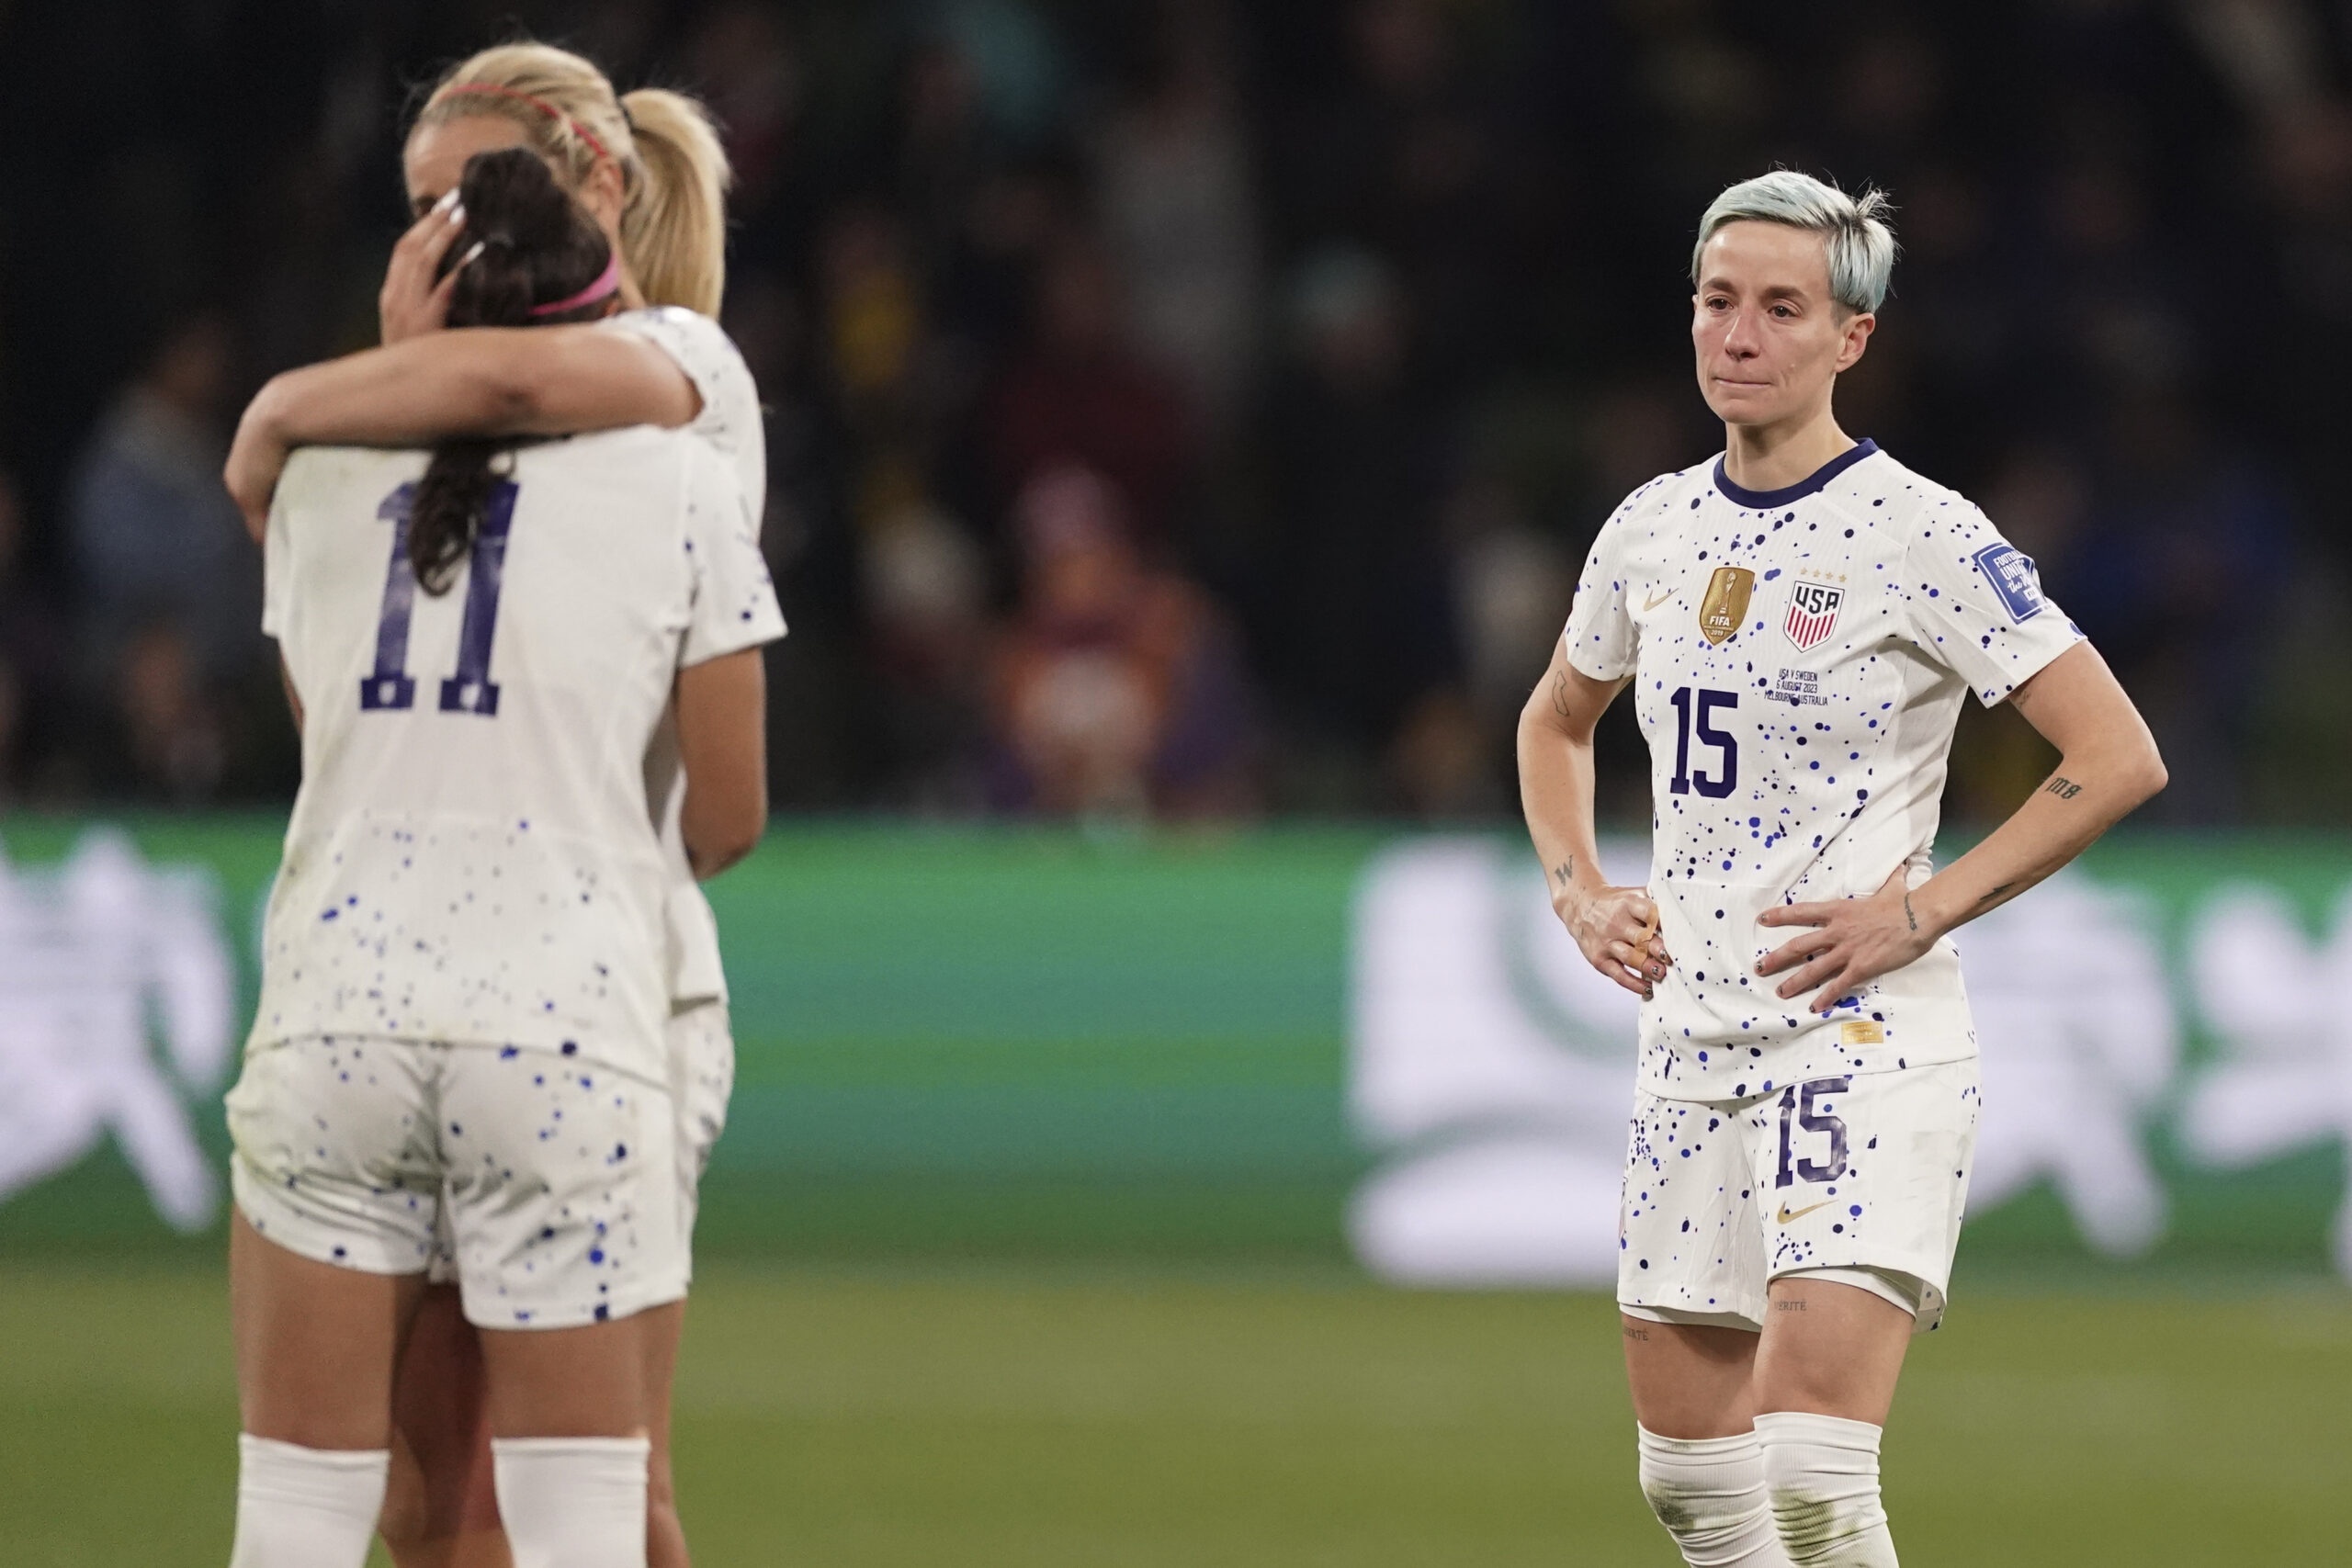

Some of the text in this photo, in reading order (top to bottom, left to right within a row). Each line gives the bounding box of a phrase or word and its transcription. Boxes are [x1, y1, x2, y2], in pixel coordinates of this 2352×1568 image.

[360, 480, 521, 717] 11
[1795, 586, 1840, 614] USA
[1709, 615, 1730, 626] FIFA
[1779, 668, 1790, 679] USA
[1795, 671, 1818, 682] SWEDEN
[1776, 680, 1818, 694] 6 AUGUST 2023
[1797, 694, 1828, 705] AUSTRALIA
[1670, 686, 1738, 799] 15
[1776, 1078, 1849, 1190] 15
